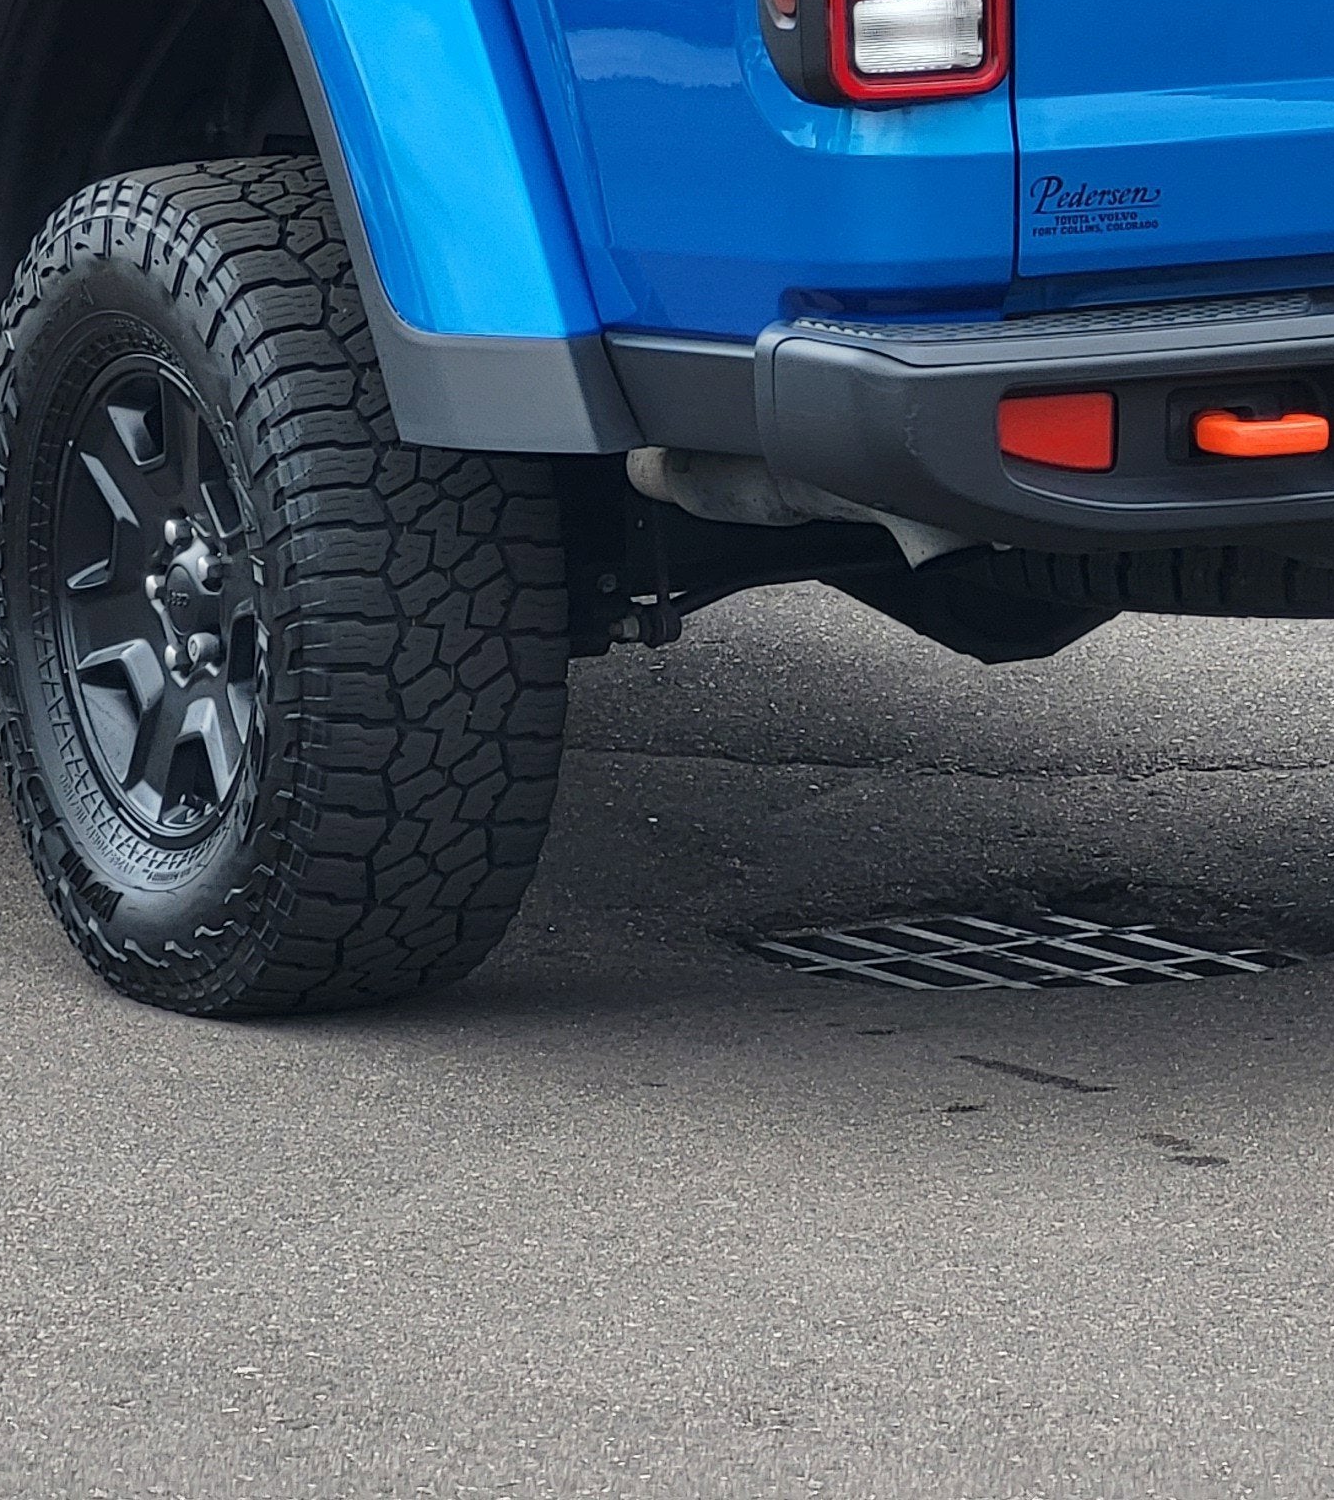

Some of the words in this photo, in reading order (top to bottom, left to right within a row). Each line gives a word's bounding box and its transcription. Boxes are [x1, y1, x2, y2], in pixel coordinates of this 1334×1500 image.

[1029, 175, 1161, 214] Pedersen
[1054, 214, 1090, 226] TOYOTA
[1098, 211, 1138, 223] VOLVO
[1033, 226, 1057, 237] FORT
[1106, 219, 1159, 232] COLORADO
